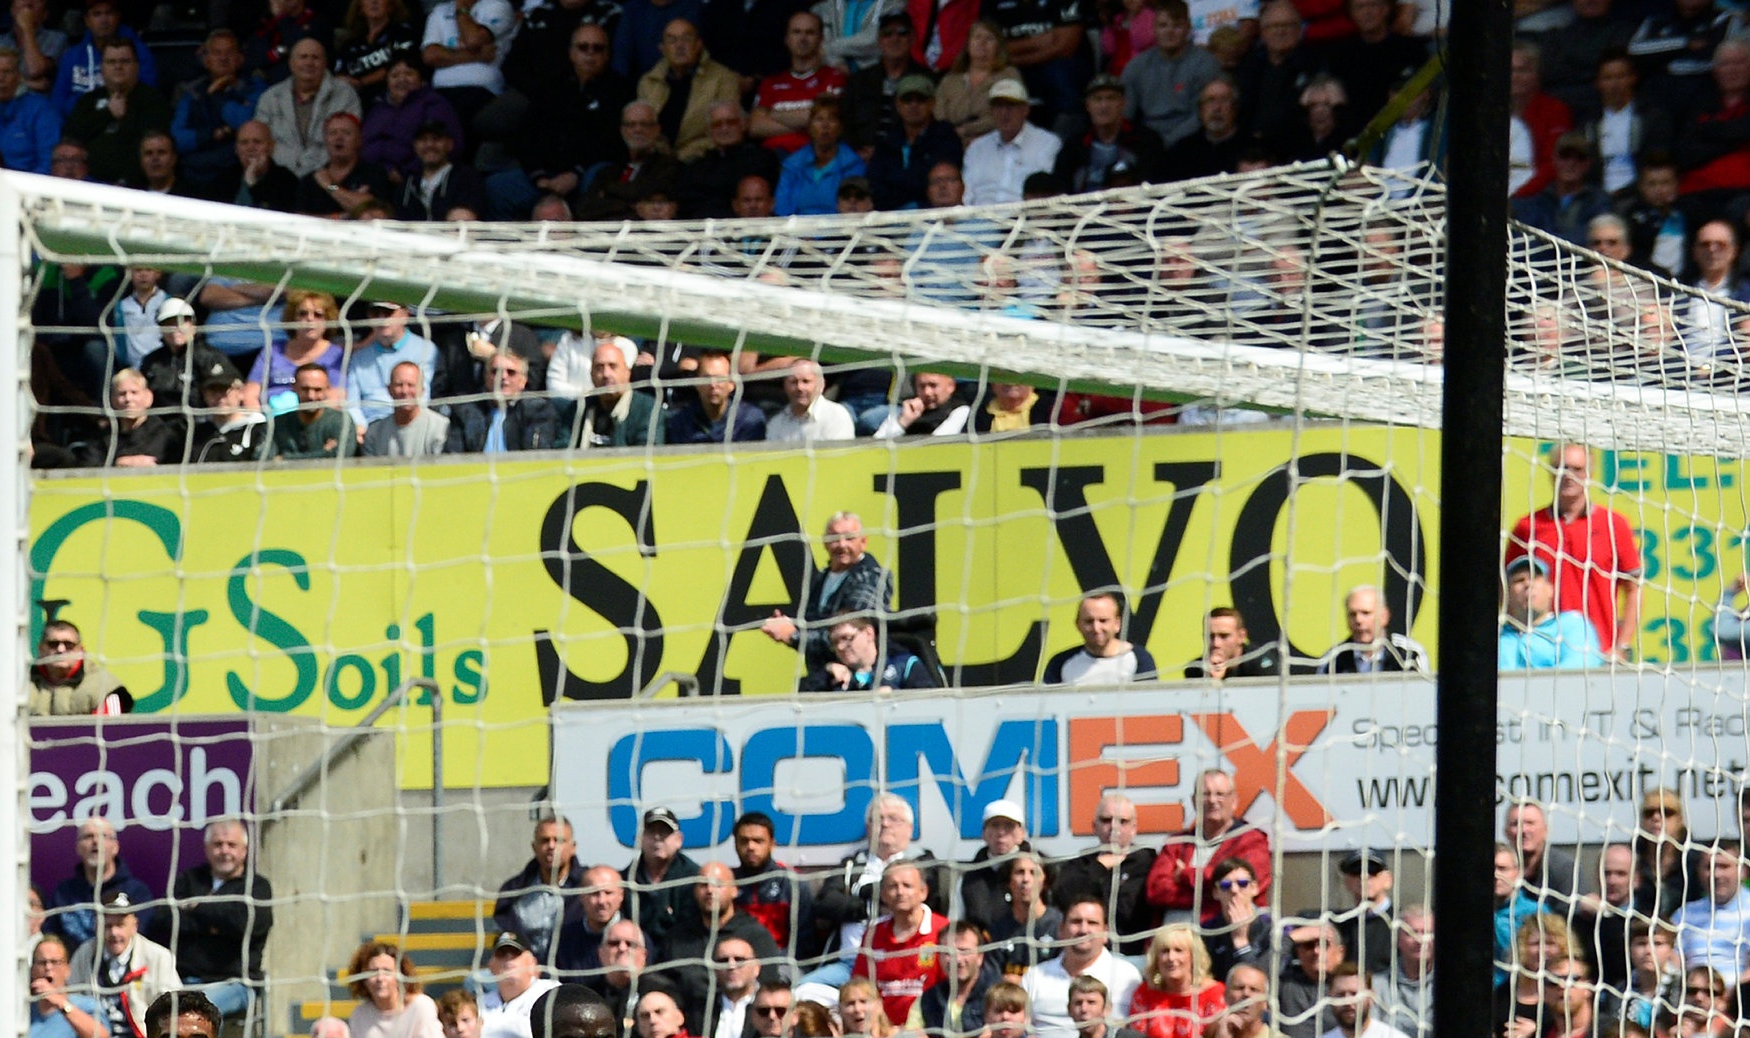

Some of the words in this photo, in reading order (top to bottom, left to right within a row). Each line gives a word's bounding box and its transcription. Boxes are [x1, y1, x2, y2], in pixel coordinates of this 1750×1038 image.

[227, 548, 489, 713] Soils
[534, 451, 1427, 706] SALVO
[607, 709, 1337, 848] COMEX
[1352, 716, 1524, 752] Specst
